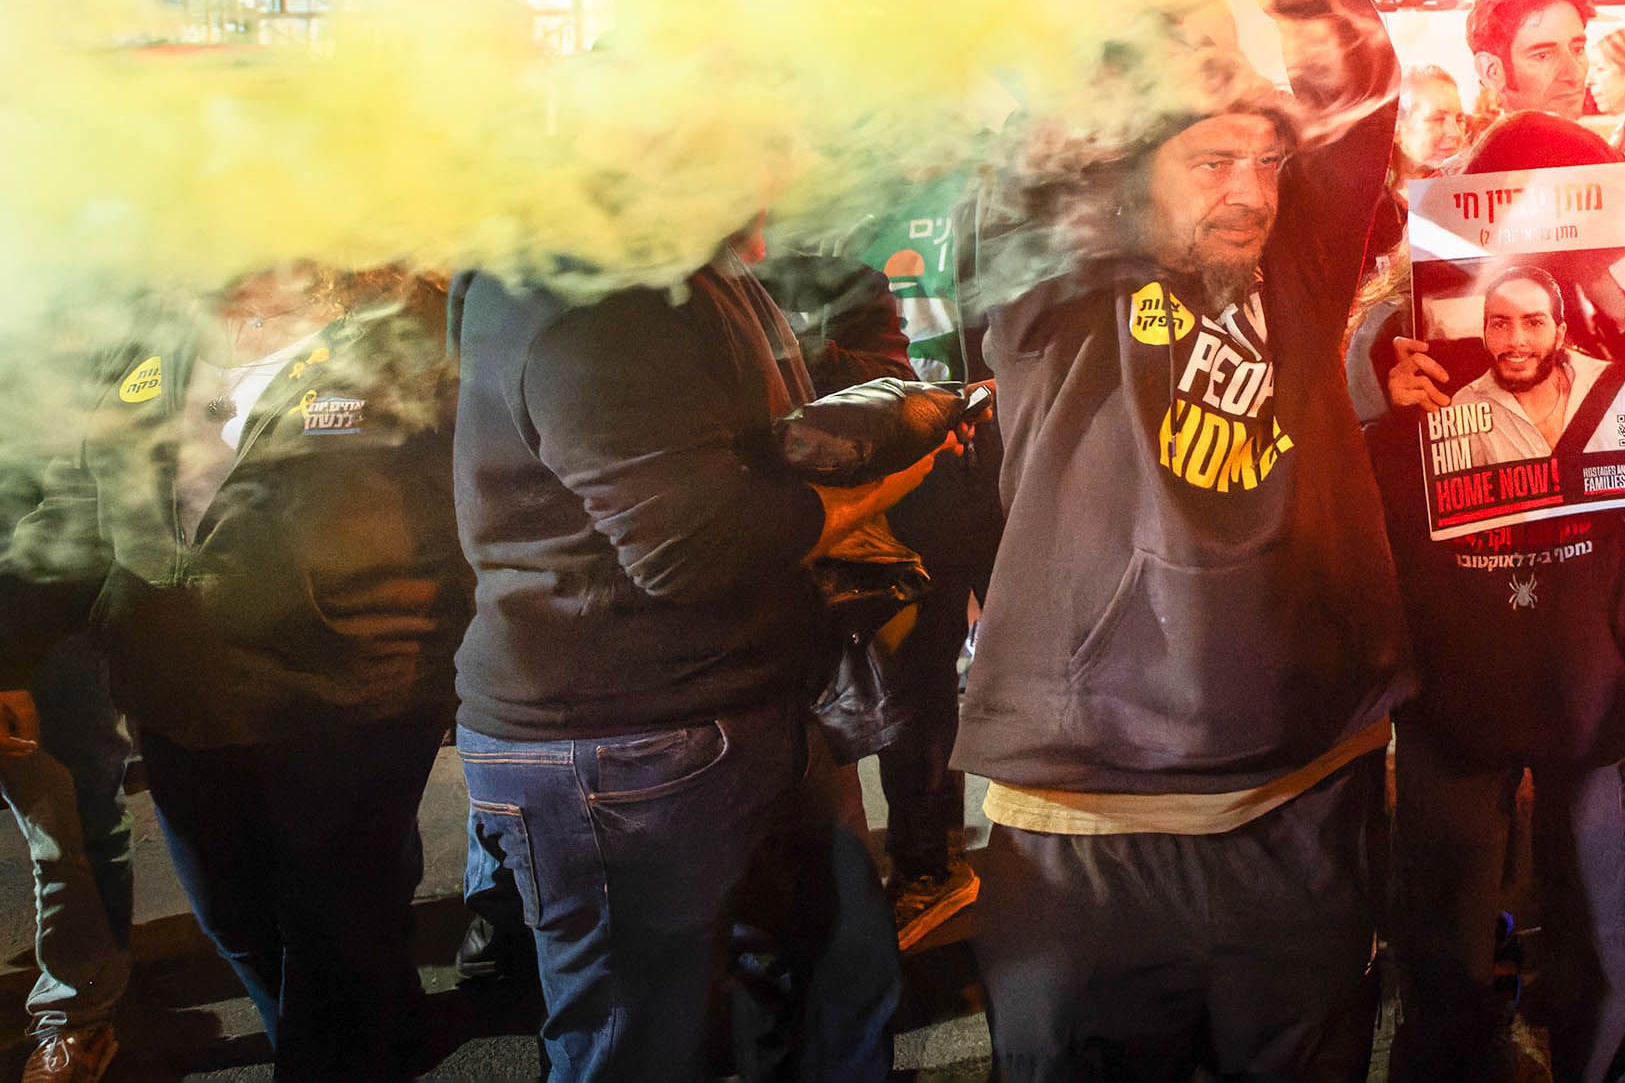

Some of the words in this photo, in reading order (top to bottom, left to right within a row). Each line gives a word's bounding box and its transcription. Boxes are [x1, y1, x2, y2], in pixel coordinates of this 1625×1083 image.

[1453, 190, 1479, 220] חי
[126, 378, 161, 393] פקה
[1427, 403, 1493, 440] BRING
[1431, 437, 1472, 476] HIM
[1583, 465, 1616, 478] HOSTAGES
[1584, 475, 1625, 492] FAMILIES
[1435, 468, 1495, 513] HOME
[1499, 458, 1561, 500] NOW!
[1554, 540, 1593, 563] נחטף
